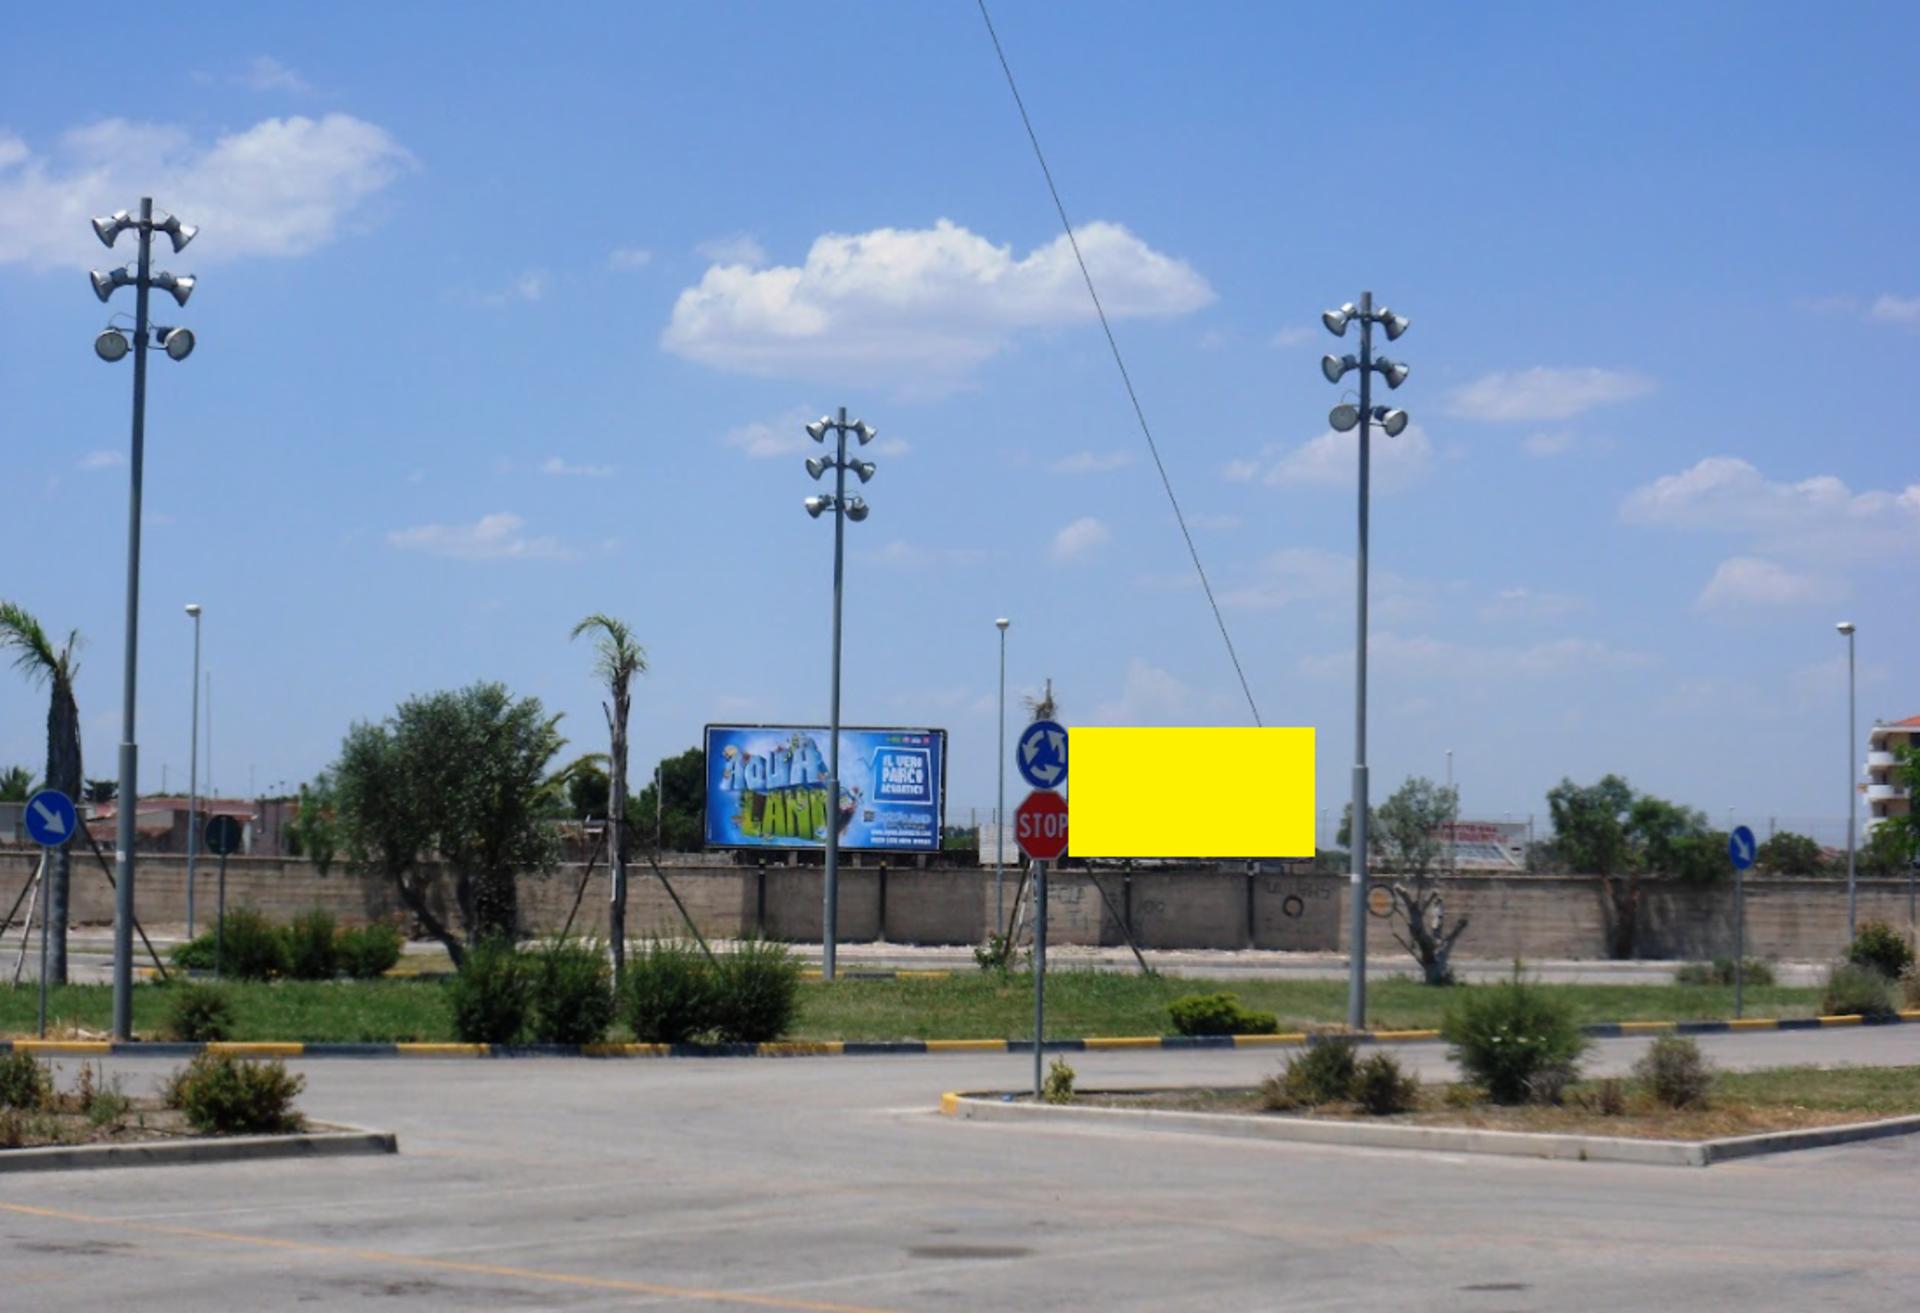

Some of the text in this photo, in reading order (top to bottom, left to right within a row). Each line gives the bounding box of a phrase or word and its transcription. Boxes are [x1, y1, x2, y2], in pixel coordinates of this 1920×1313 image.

[719, 735, 829, 790] AQUA
[882, 767, 924, 784] PARCO
[1019, 812, 1068, 838] STOP
